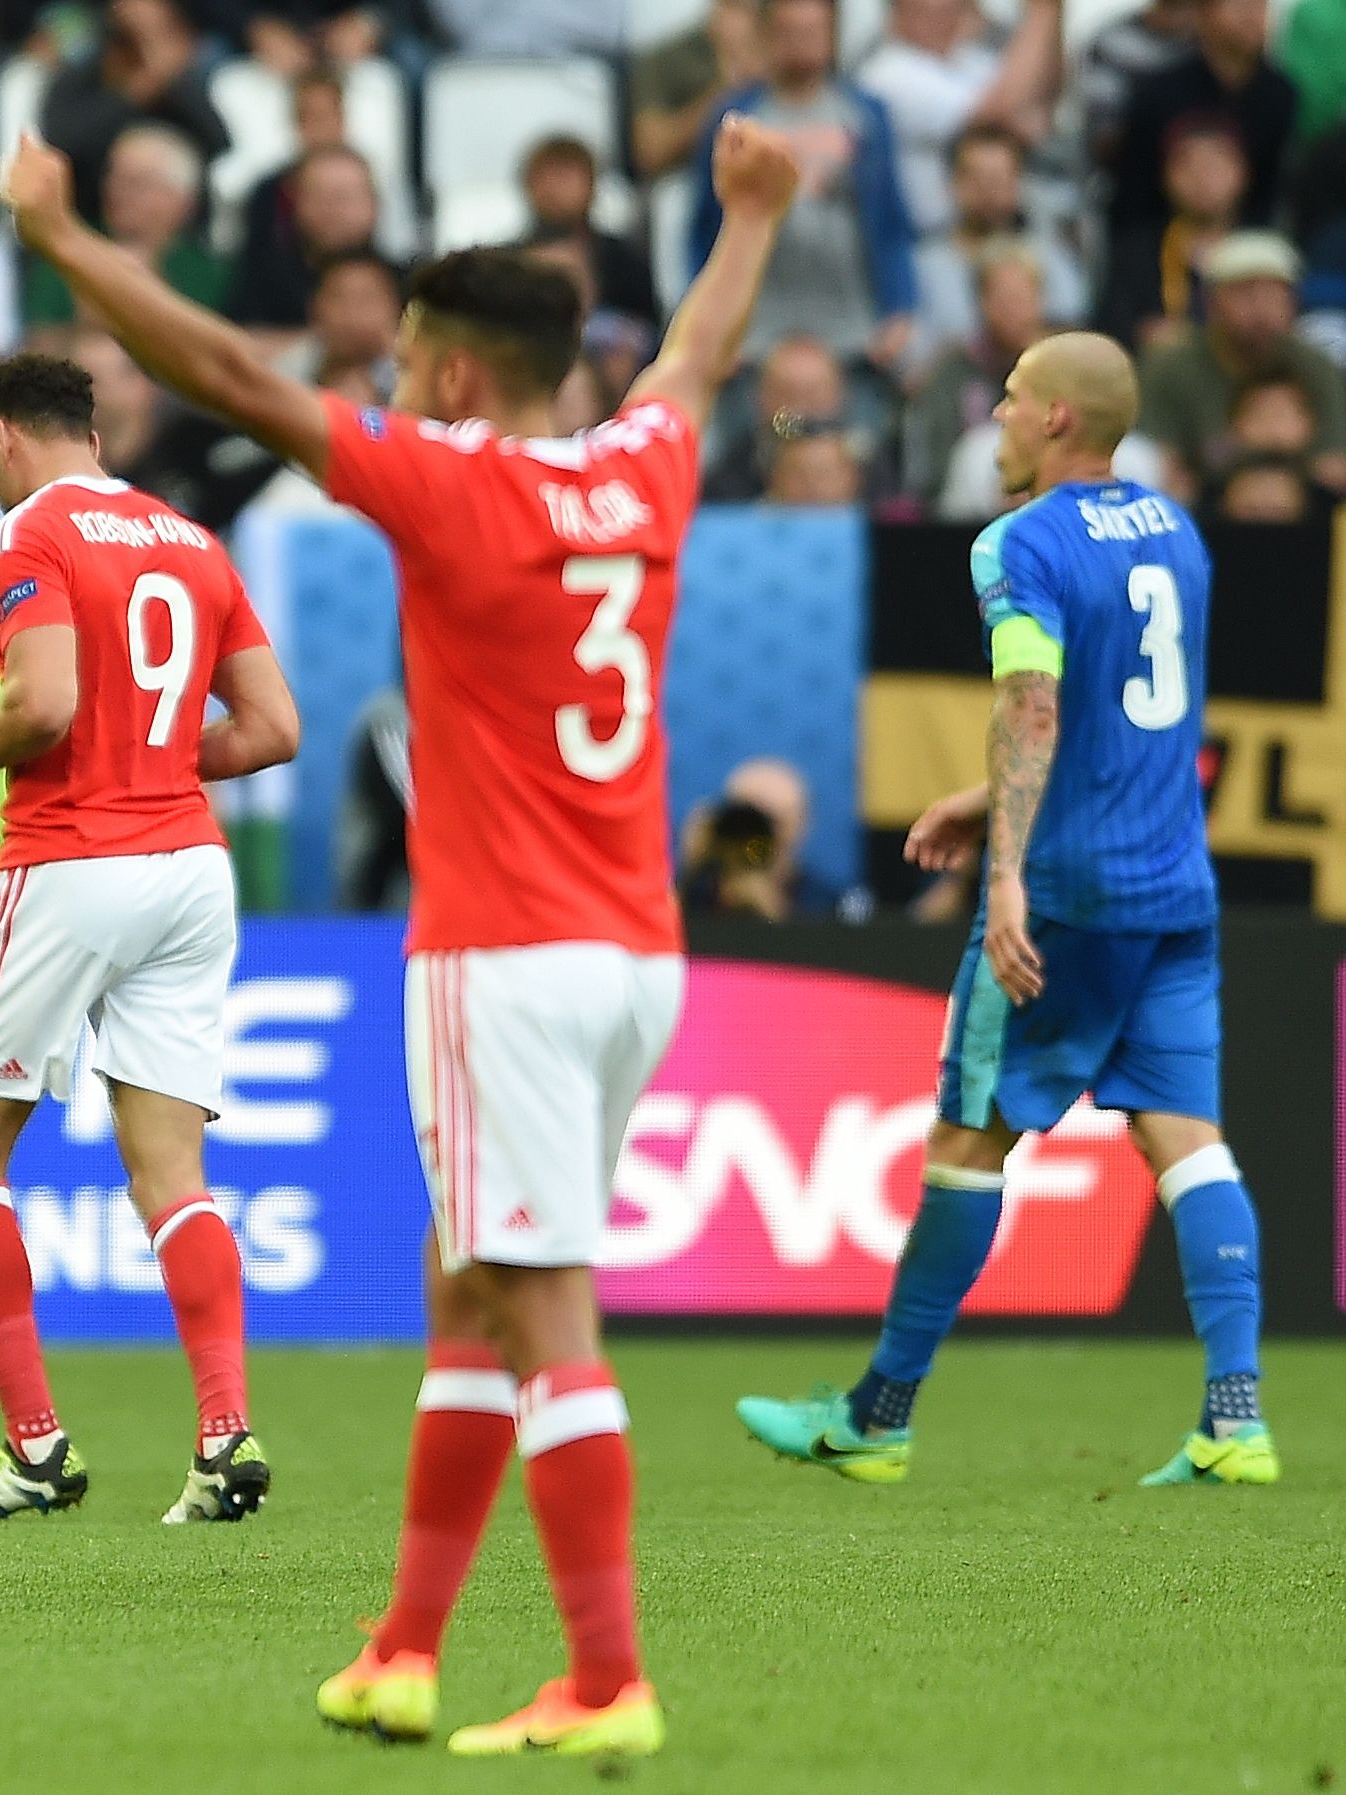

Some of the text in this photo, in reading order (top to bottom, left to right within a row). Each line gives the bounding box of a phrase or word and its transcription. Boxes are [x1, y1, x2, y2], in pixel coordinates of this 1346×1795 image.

[126, 572, 195, 747] 9
[555, 553, 653, 784] 3
[1122, 564, 1188, 731] 3
[592, 1092, 1132, 1266] SNCF
